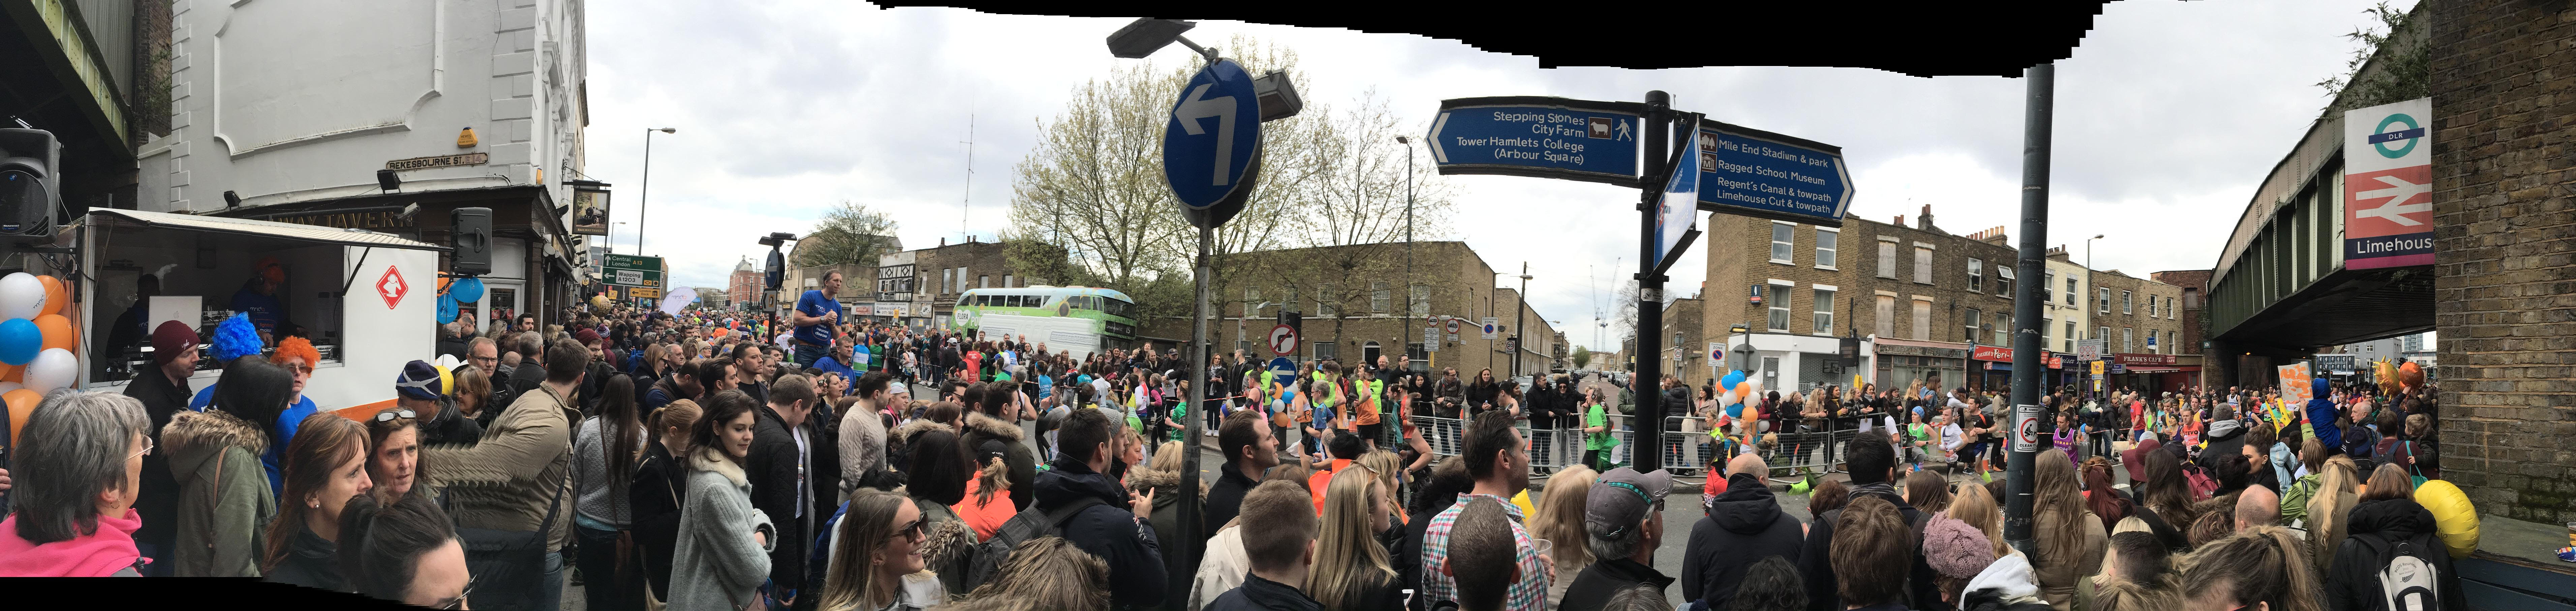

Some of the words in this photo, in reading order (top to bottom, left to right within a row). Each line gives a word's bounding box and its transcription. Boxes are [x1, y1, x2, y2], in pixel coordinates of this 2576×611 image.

[1494, 111, 1544, 123] Stepping
[1547, 113, 1584, 125] Stones
[1532, 124, 1554, 136] City
[1556, 125, 1584, 138] Farm
[1457, 137, 1487, 146] Tower
[1490, 136, 1538, 147] Hamlets
[1543, 138, 1584, 153] College
[1495, 148, 1539, 160] (Arbour
[1544, 150, 1584, 165] Square)
[1719, 139, 1738, 151] Mile
[1742, 143, 1759, 155] End
[1762, 147, 1797, 162] Stadium
[1800, 155, 1806, 163] &
[1809, 158, 1828, 168] park
[390, 158, 451, 169] BEKESBOURNE
[1718, 160, 1753, 173] Ragged
[1756, 165, 1787, 179] School
[1791, 172, 1825, 186] Museum
[1718, 177, 1757, 191] Regent's
[1760, 183, 1786, 195] Canal
[1789, 188, 1795, 196] &
[1797, 189, 1832, 202] towpath
[1717, 189, 1766, 204] Limehouse
[1769, 196, 1785, 207] Cut
[1787, 199, 1793, 208] &
[1796, 200, 1830, 214] towpath
[324, 212, 413, 228] TAVERN
[2357, 237, 2435, 254] Limehous
[1994, 349, 2013, 360] Peri-
[1587, 510, 1605, 519] Mercedes
